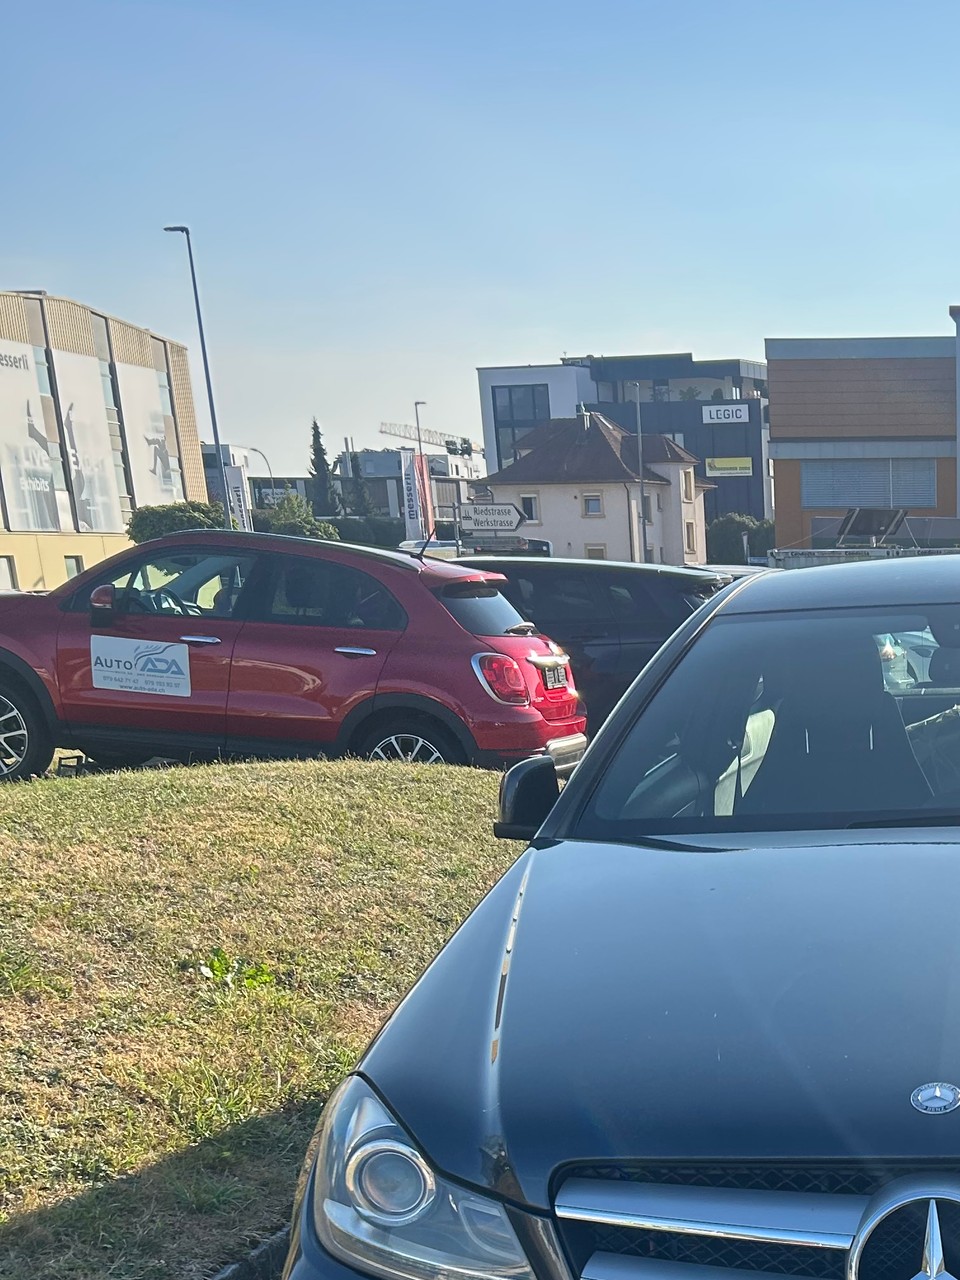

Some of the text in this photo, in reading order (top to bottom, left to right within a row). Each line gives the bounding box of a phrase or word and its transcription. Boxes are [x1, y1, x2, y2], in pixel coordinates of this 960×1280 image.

[709, 409, 742, 419] LEGIC
[405, 473, 416, 520] messerli
[473, 507, 512, 516] Riedstrasse
[473, 518, 514, 527] Werkstrasse
[94, 656, 133, 670] AUTO
[140, 657, 186, 676] ADA
